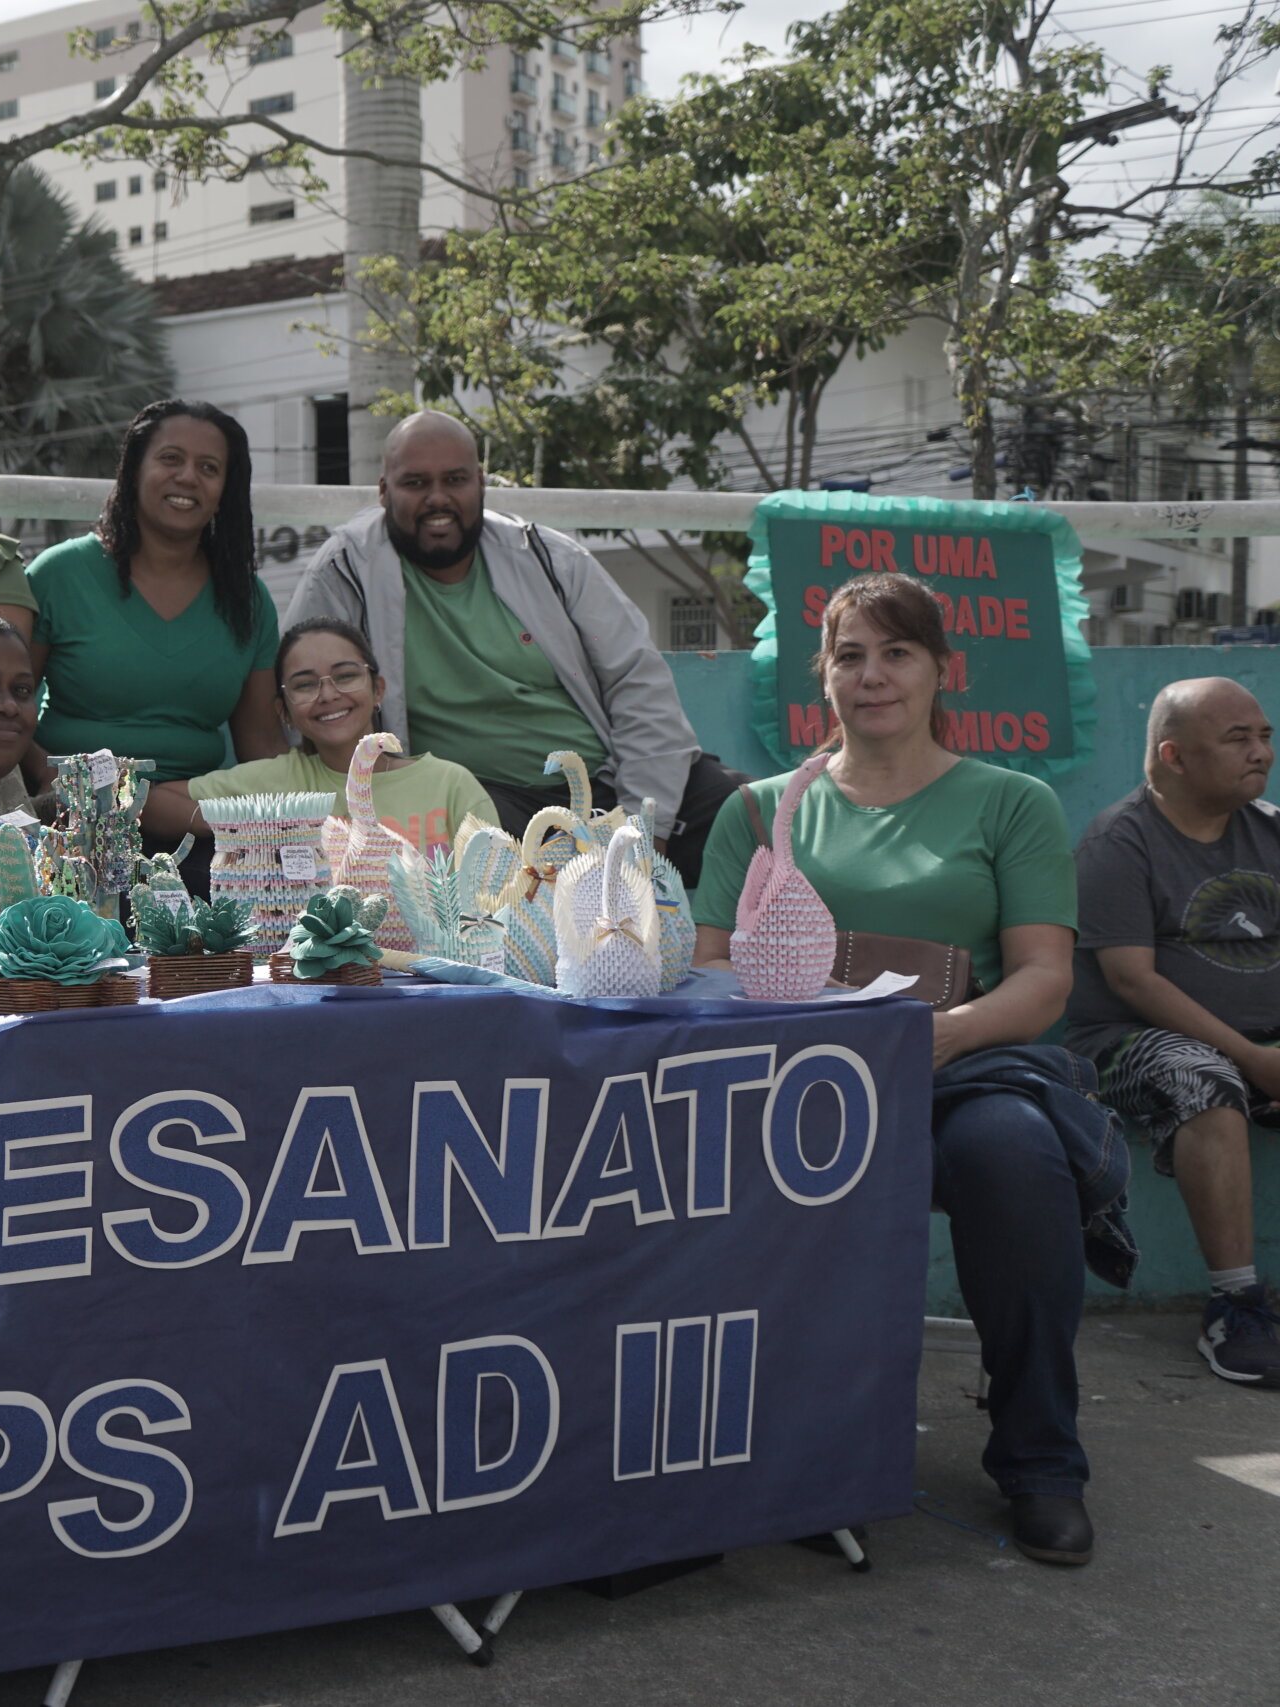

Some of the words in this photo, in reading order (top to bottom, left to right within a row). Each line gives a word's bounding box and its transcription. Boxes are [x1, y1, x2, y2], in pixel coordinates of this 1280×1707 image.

[821, 525, 898, 572] POR
[913, 534, 998, 579] UMA
[802, 585, 1031, 640] SDADE
[788, 703, 1050, 752] MMIOS
[273, 1335, 560, 1538] AD
[614, 1309, 758, 1482] III
